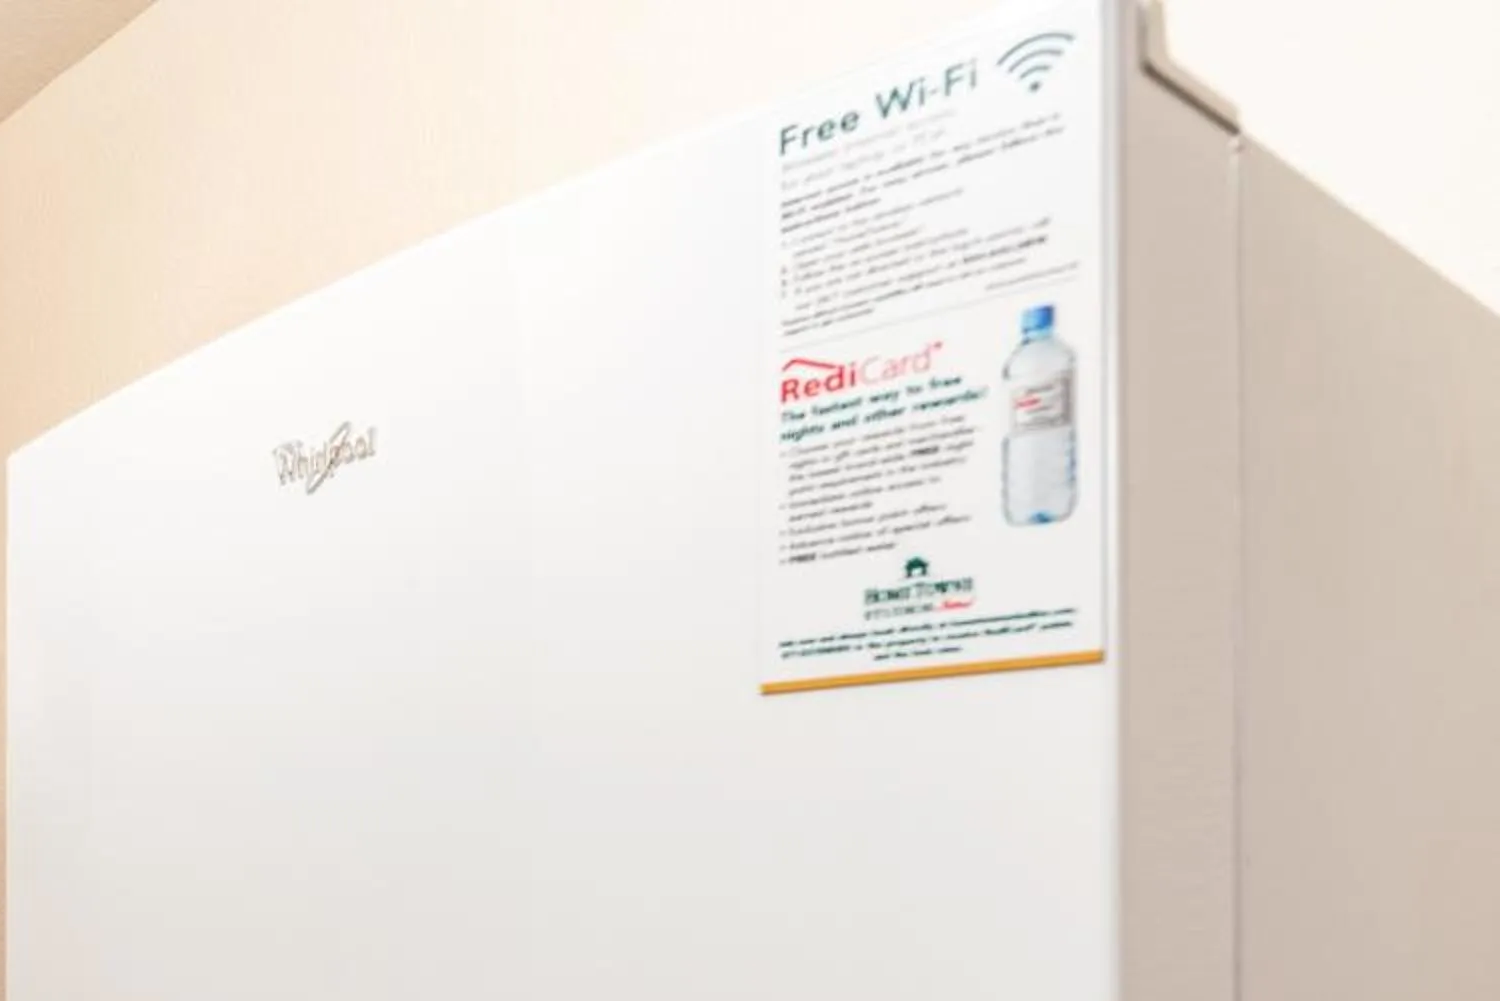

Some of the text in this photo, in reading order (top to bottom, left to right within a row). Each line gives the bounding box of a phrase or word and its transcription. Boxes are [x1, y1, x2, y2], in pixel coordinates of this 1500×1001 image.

[779, 110, 860, 156] Free
[874, 58, 978, 120] Wi-Fi
[781, 424, 825, 442] nights
[831, 415, 858, 430] and
[864, 406, 906, 424] other
[782, 410, 806, 422] The
[869, 390, 900, 404] way
[906, 383, 923, 395] to
[929, 375, 962, 388] free
[272, 421, 377, 494] Whirlpool
